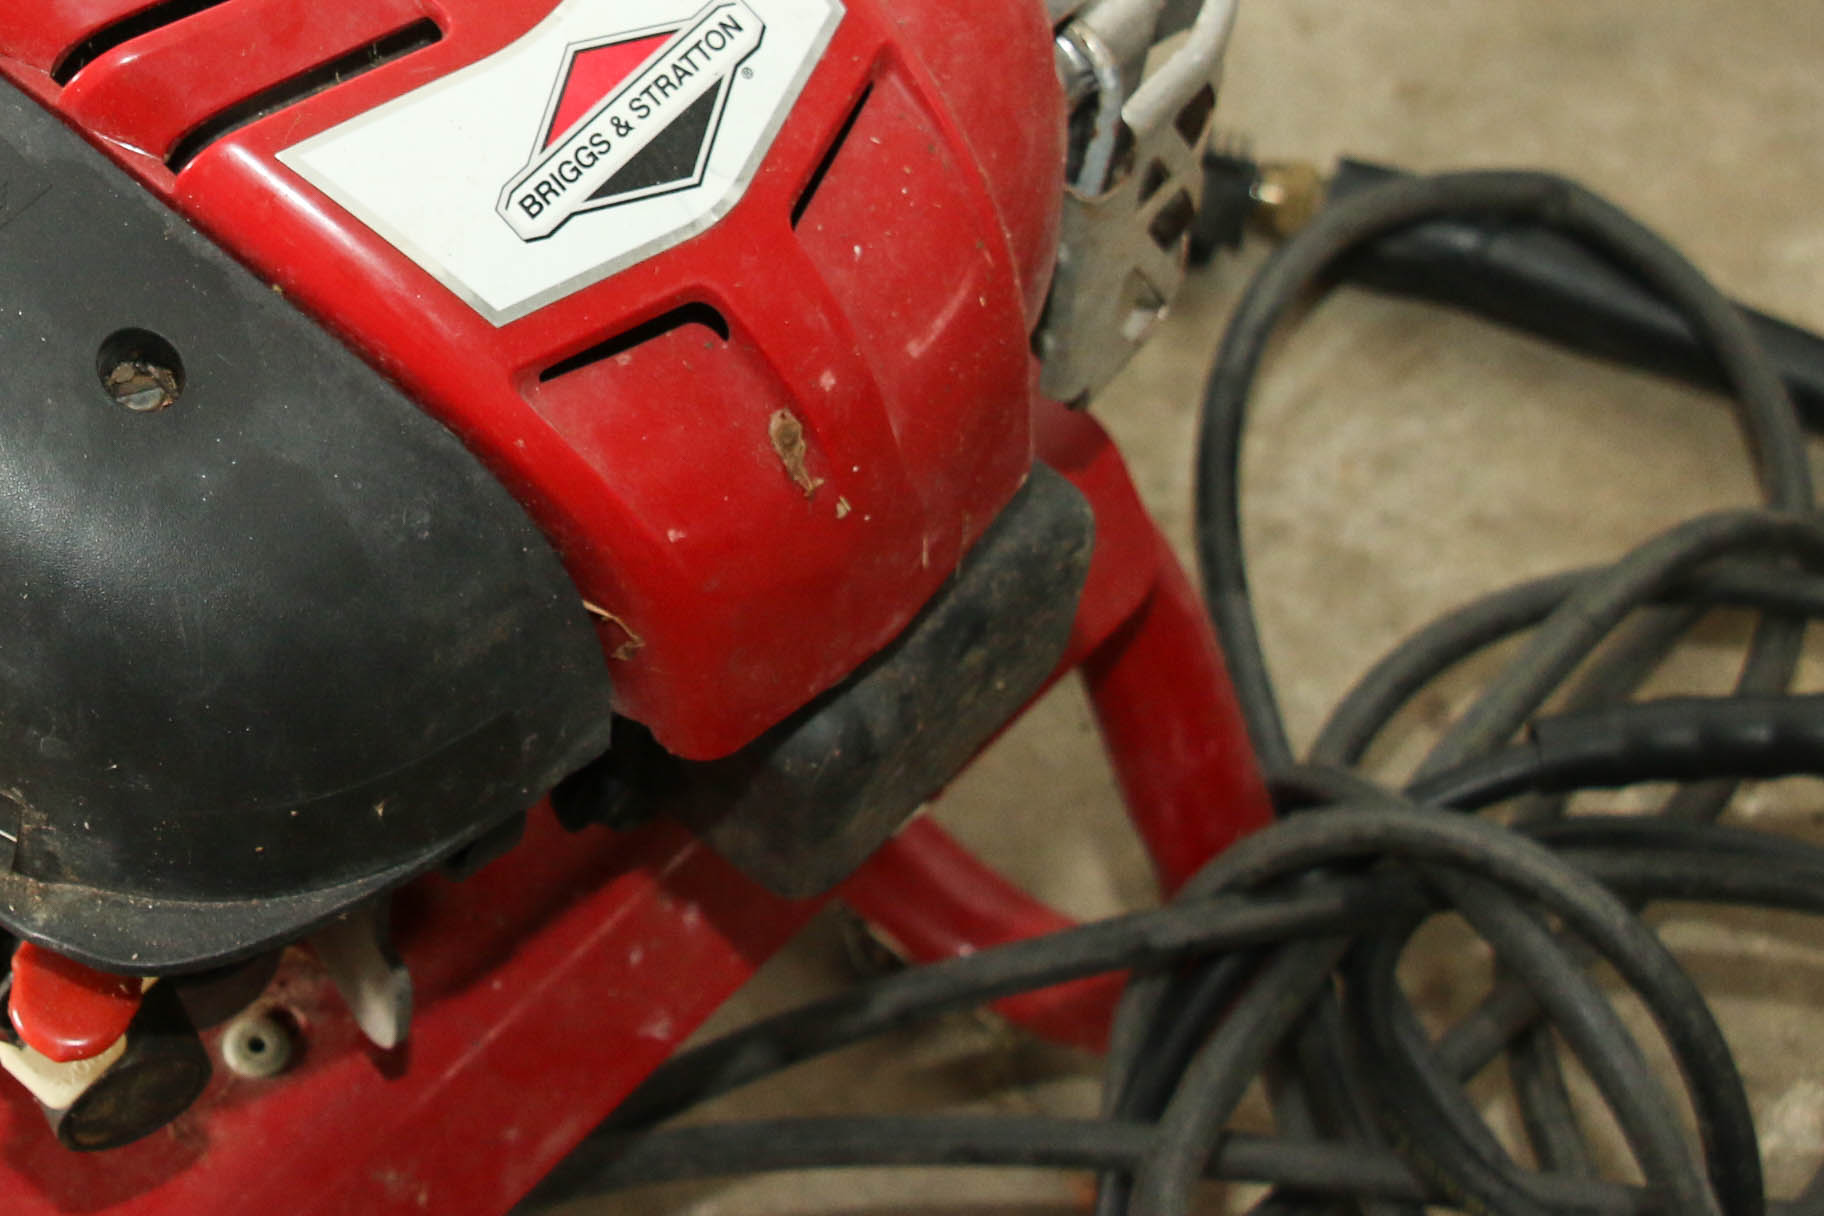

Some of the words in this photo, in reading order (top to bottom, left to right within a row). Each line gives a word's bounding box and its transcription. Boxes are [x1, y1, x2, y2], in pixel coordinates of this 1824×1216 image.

[519, 131, 612, 220] BRIGGS
[611, 114, 633, 138] &
[628, 14, 744, 122] STRATTON
